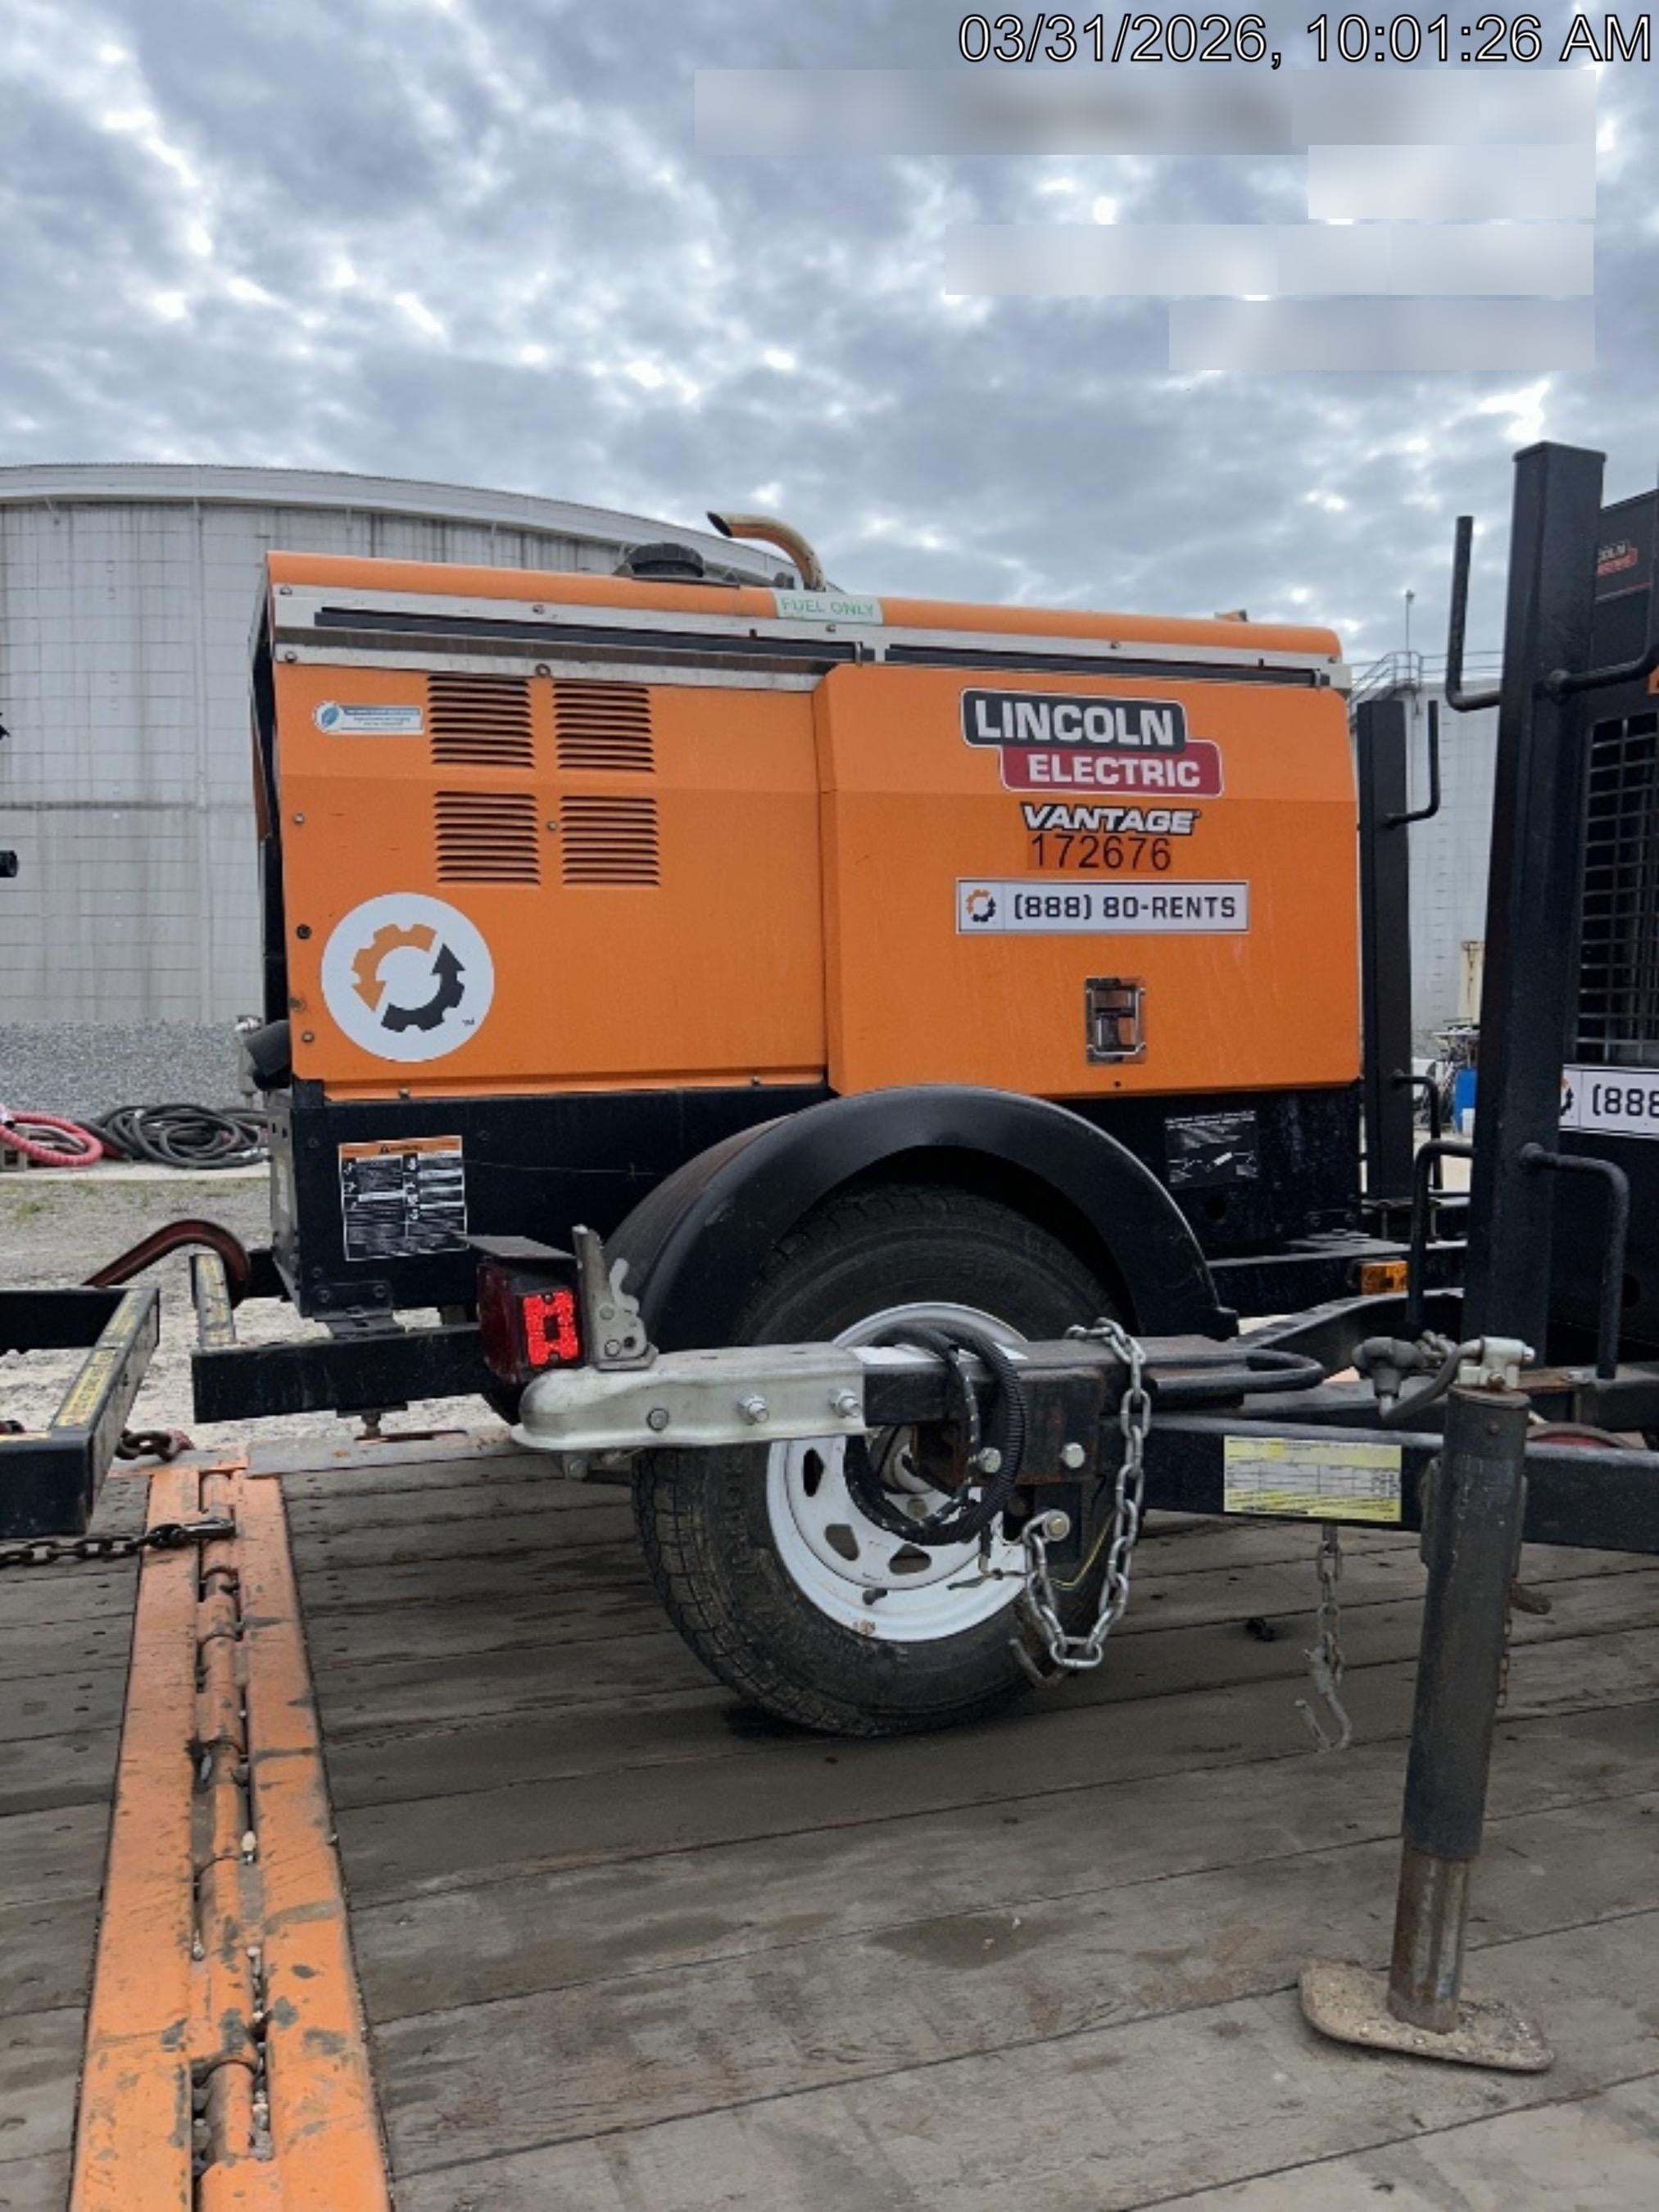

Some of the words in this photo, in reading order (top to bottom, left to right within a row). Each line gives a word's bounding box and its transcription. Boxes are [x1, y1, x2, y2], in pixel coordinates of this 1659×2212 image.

[781, 597, 825, 613] FUEL
[831, 601, 873, 616] ONLY
[975, 700, 1175, 746] LINCOLN
[1027, 754, 1201, 787] ELECTRIC
[1021, 802, 1196, 835] VANTAGE
[1031, 834, 1172, 871] 172676
[1013, 893, 1092, 921] (888)
[1103, 895, 1236, 919] 80-RENTS
